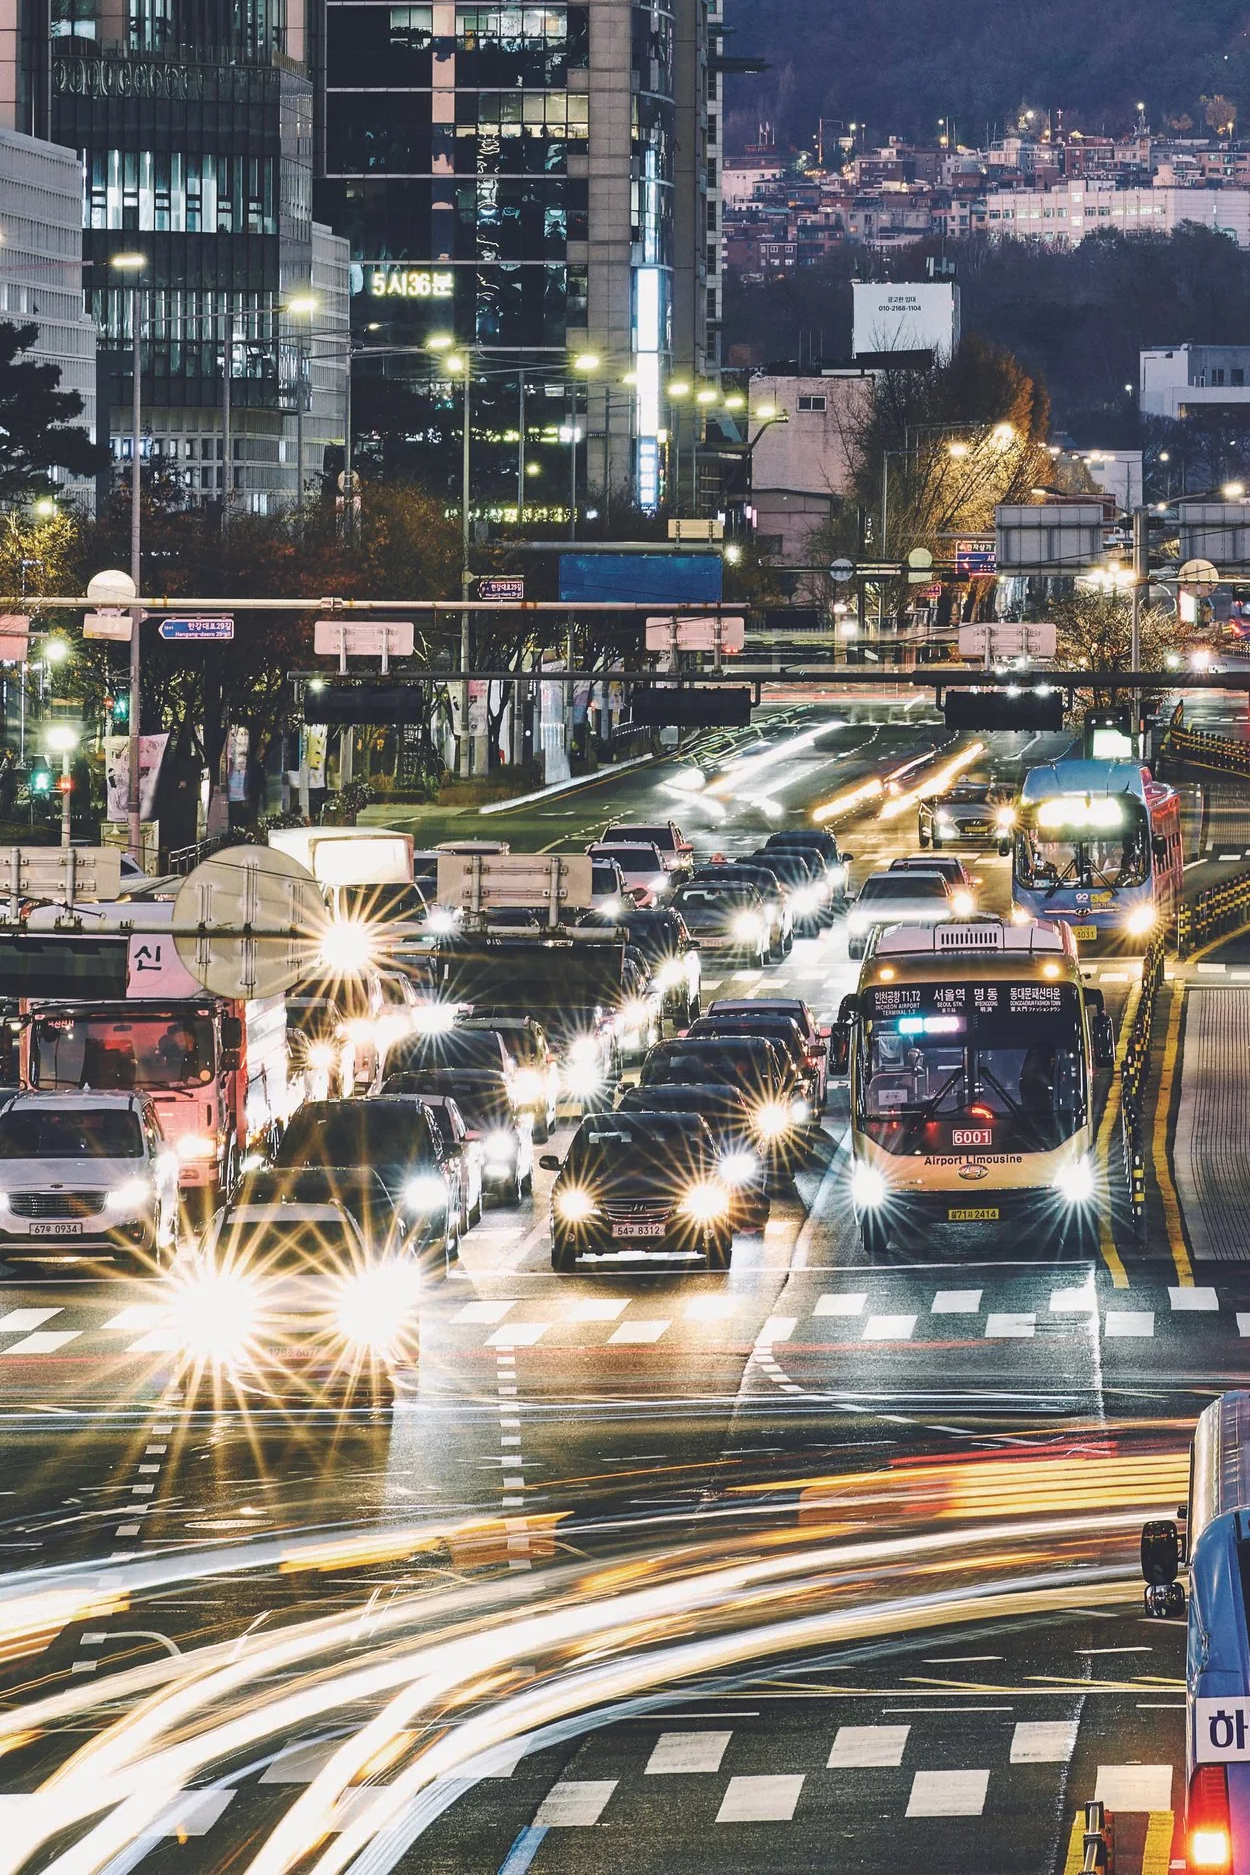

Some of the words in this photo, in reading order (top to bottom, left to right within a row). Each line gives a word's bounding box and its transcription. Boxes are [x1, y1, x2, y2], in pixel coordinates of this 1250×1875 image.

[187, 622, 231, 631] 한강대로29길
[1076, 931, 1095, 939] 4031
[133, 944, 162, 972] 신
[874, 990, 900, 1005] 인천공항
[901, 989, 921, 1003] T1,T2
[933, 988, 966, 1002] 서울역
[954, 1131, 991, 1144] 6001
[924, 1157, 963, 1167] Airport
[966, 1154, 1023, 1165] Limousine
[974, 1210, 996, 1219] 2414
[55, 1224, 78, 1234] 0934
[637, 1226, 661, 1235] 8312
